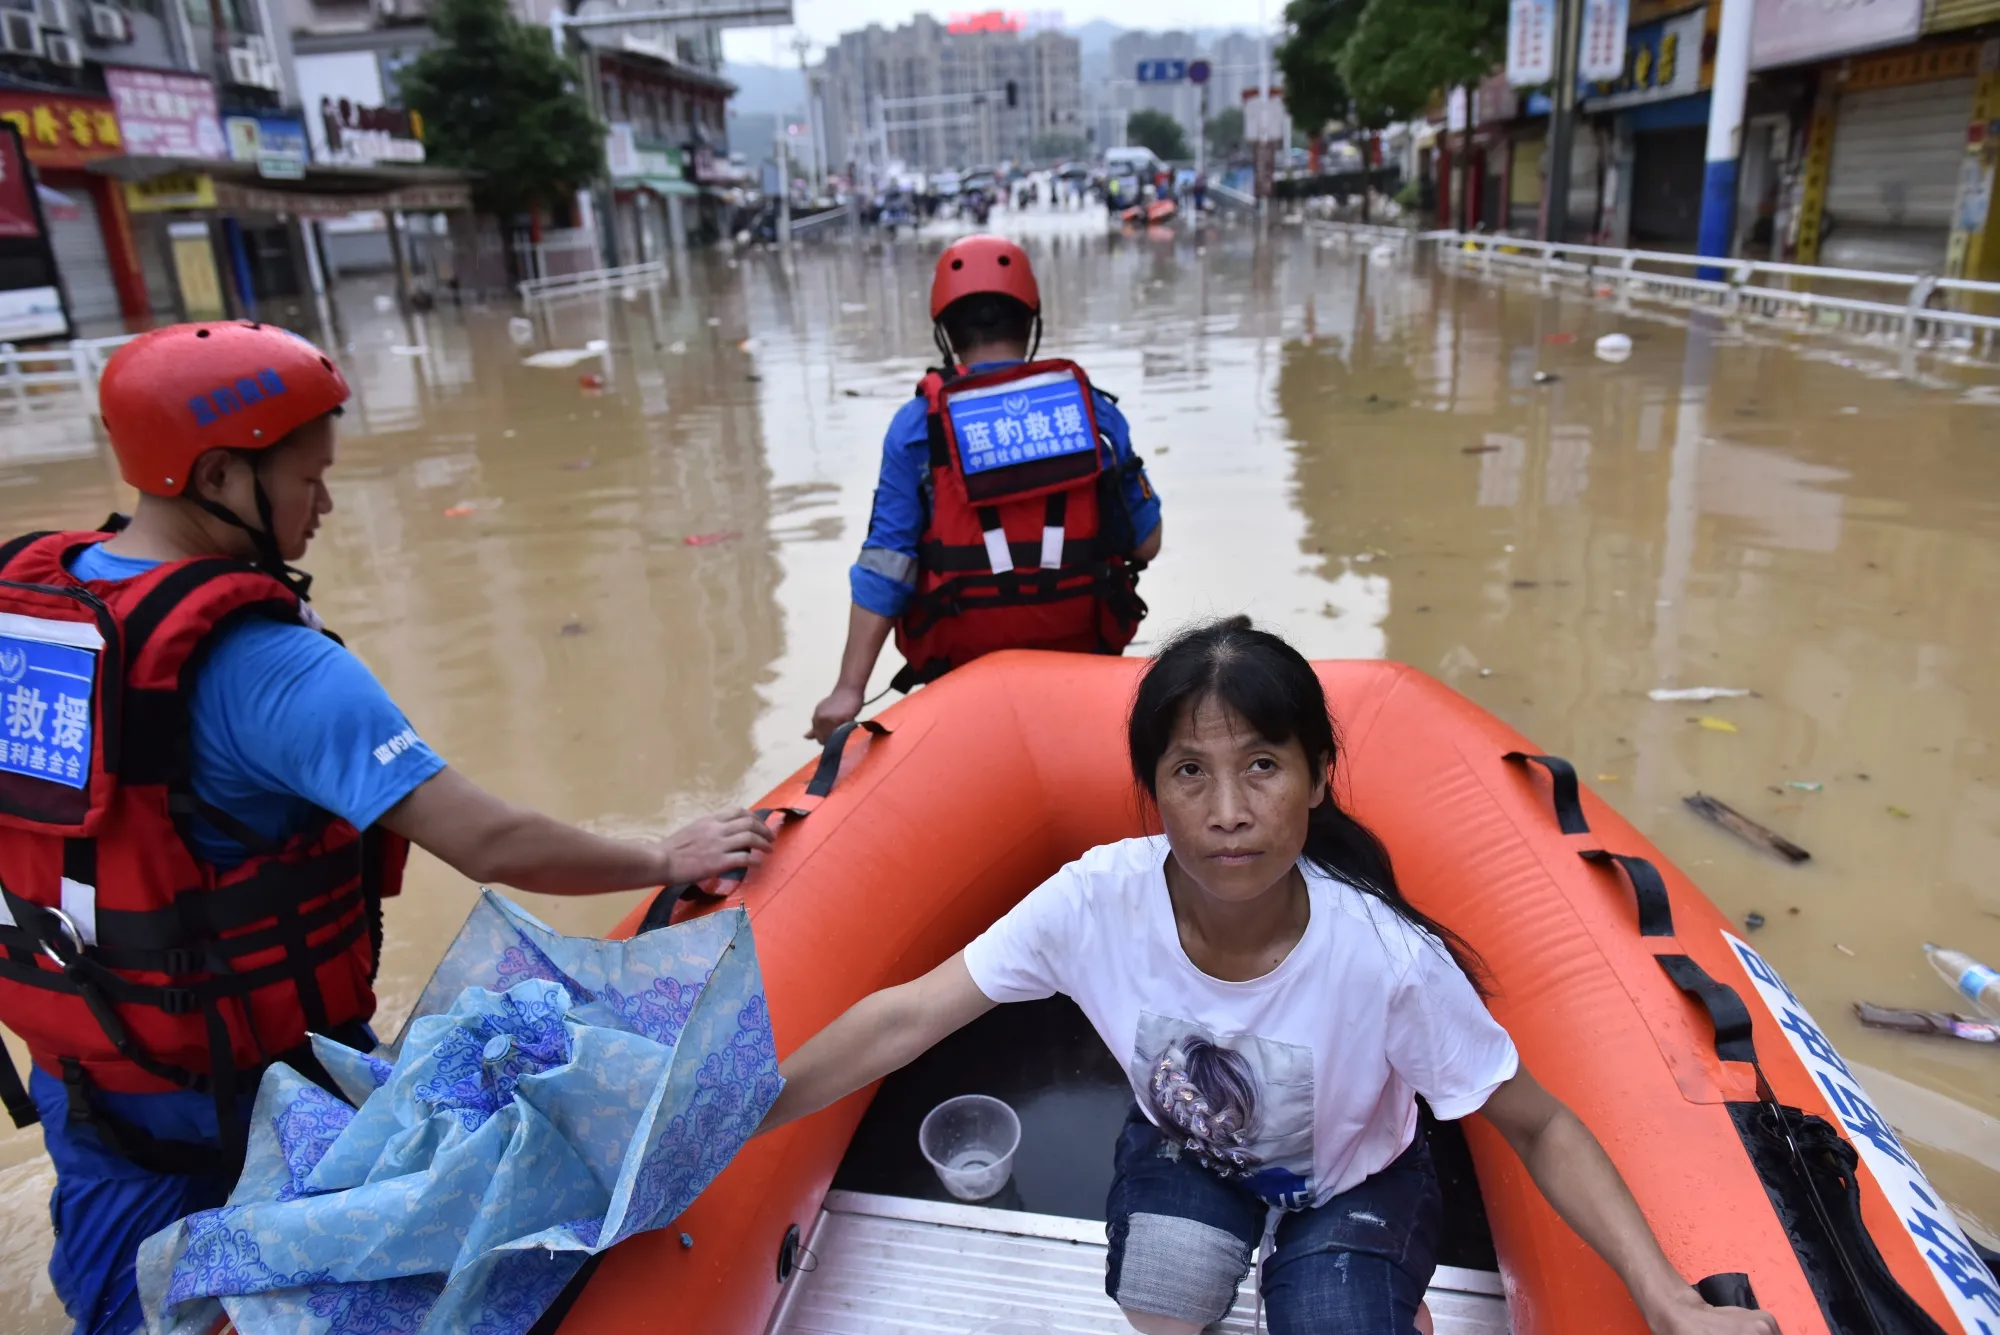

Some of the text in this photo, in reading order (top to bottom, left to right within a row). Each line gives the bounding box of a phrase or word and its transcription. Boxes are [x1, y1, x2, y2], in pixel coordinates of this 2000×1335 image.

[962, 403, 1085, 453] 蓝豹救援
[970, 434, 1088, 469] 中国社会福利基金会
[0, 684, 89, 753] 救援
